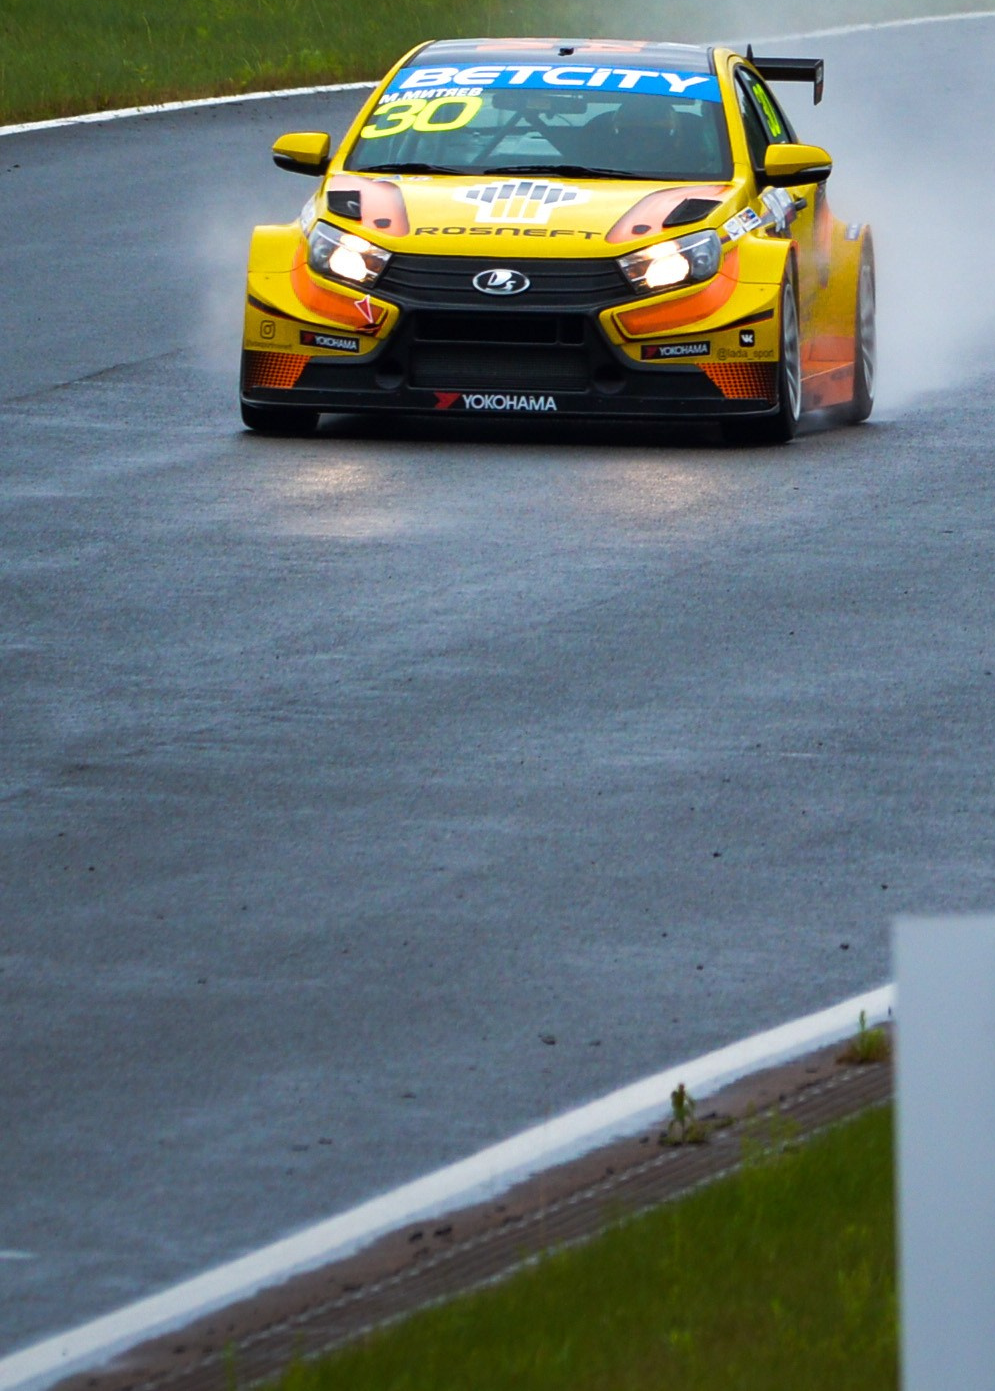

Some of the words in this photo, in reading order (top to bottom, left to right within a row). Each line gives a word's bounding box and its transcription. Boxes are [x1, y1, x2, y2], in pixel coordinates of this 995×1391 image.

[361, 96, 482, 139] 30
[415, 227, 601, 240] ROSNEFT
[659, 343, 708, 356] YOKOHAMA
[462, 394, 557, 410] YOKOHAMA
